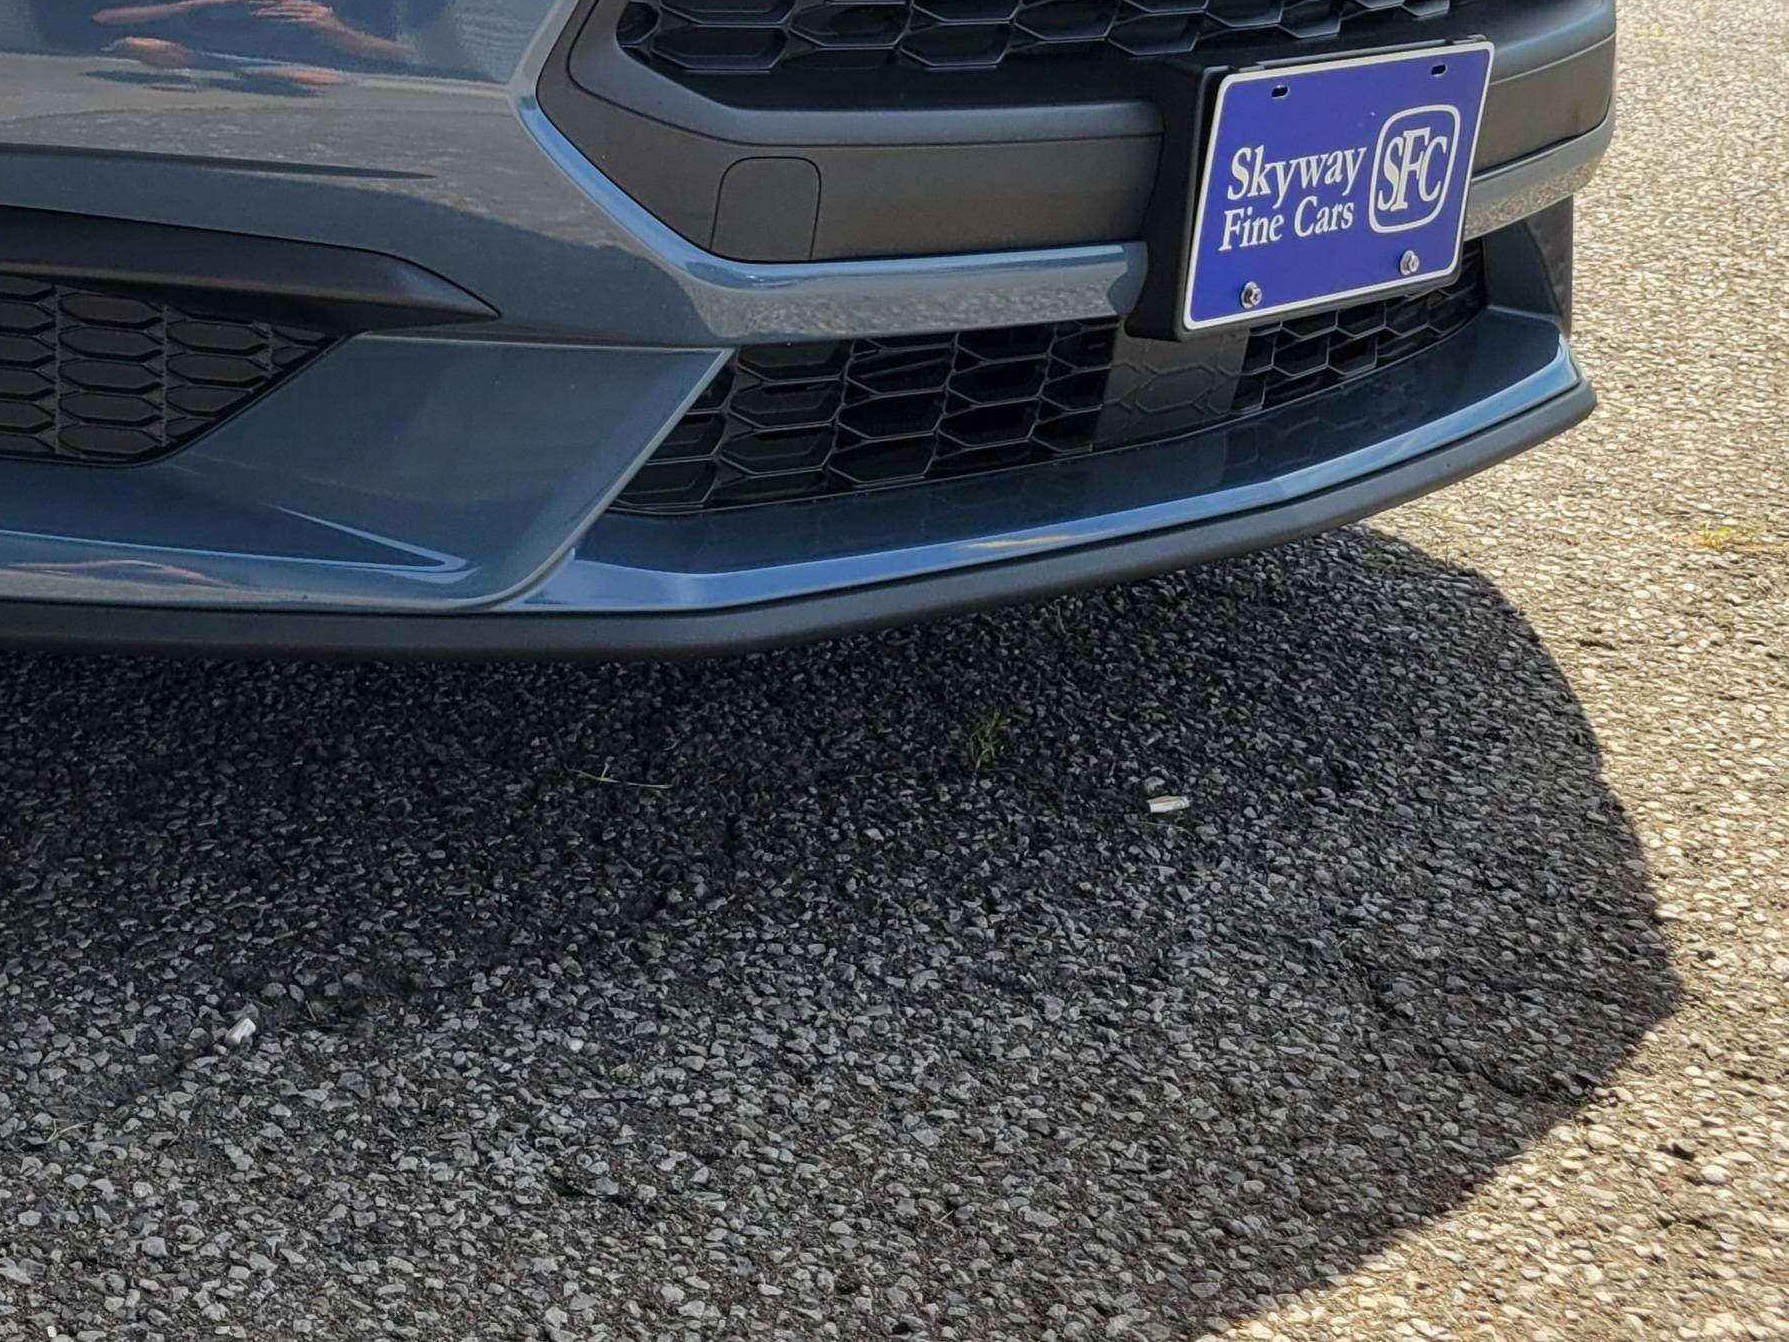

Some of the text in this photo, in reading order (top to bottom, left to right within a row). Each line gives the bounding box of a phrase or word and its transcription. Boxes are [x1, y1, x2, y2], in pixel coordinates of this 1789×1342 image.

[1227, 144, 1367, 209] Skyway
[1378, 127, 1447, 212] SFC
[1219, 196, 1355, 251] Fine Cars
